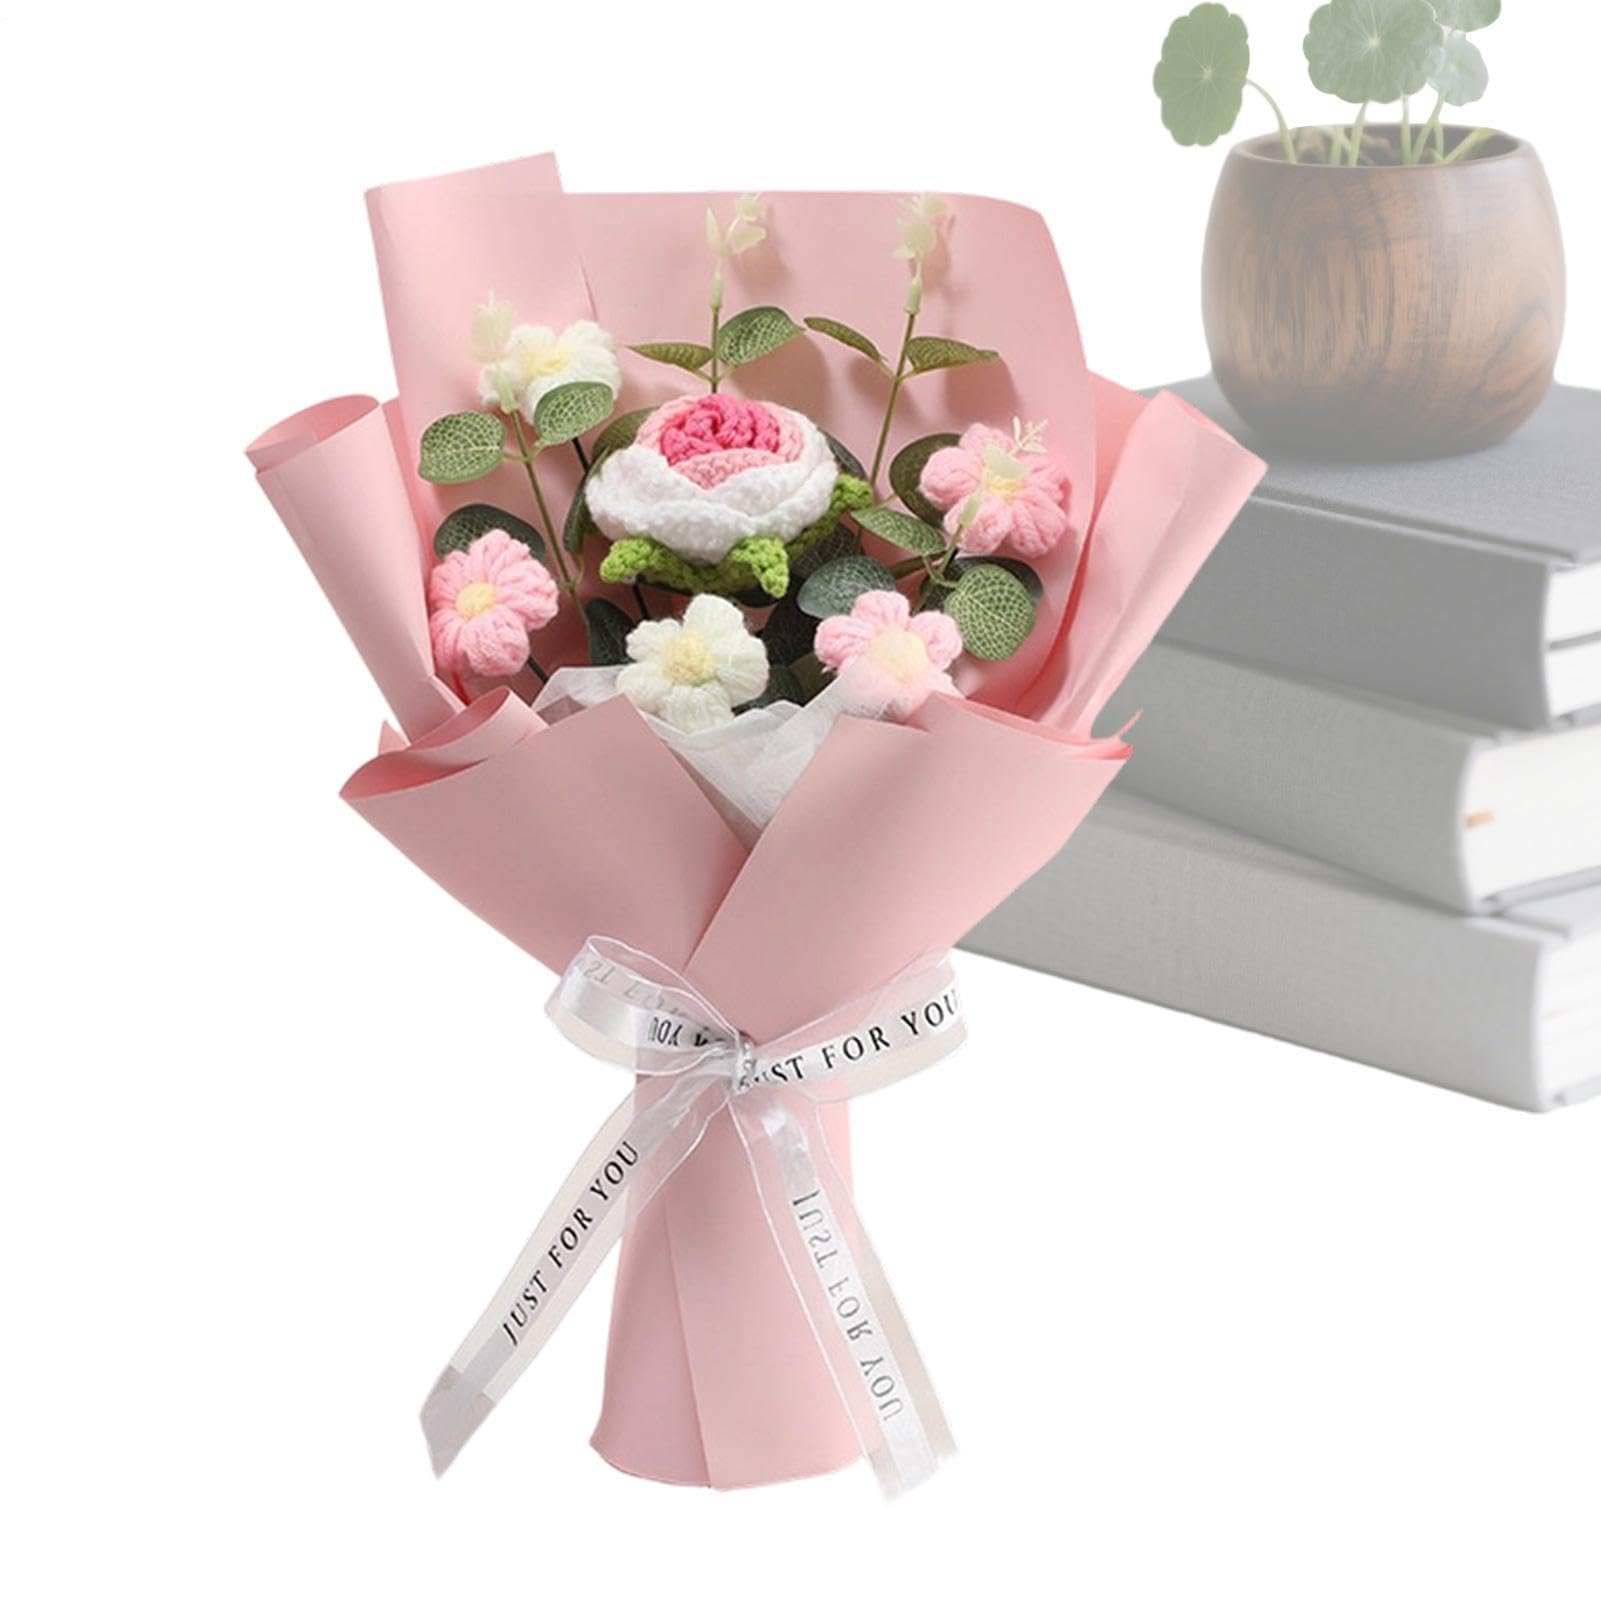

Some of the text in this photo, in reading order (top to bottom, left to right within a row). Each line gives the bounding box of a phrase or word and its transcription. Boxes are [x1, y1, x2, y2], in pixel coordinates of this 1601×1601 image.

[821, 1026, 891, 1070] FOR
[502, 1140, 640, 1346] JUST FOR YOU
